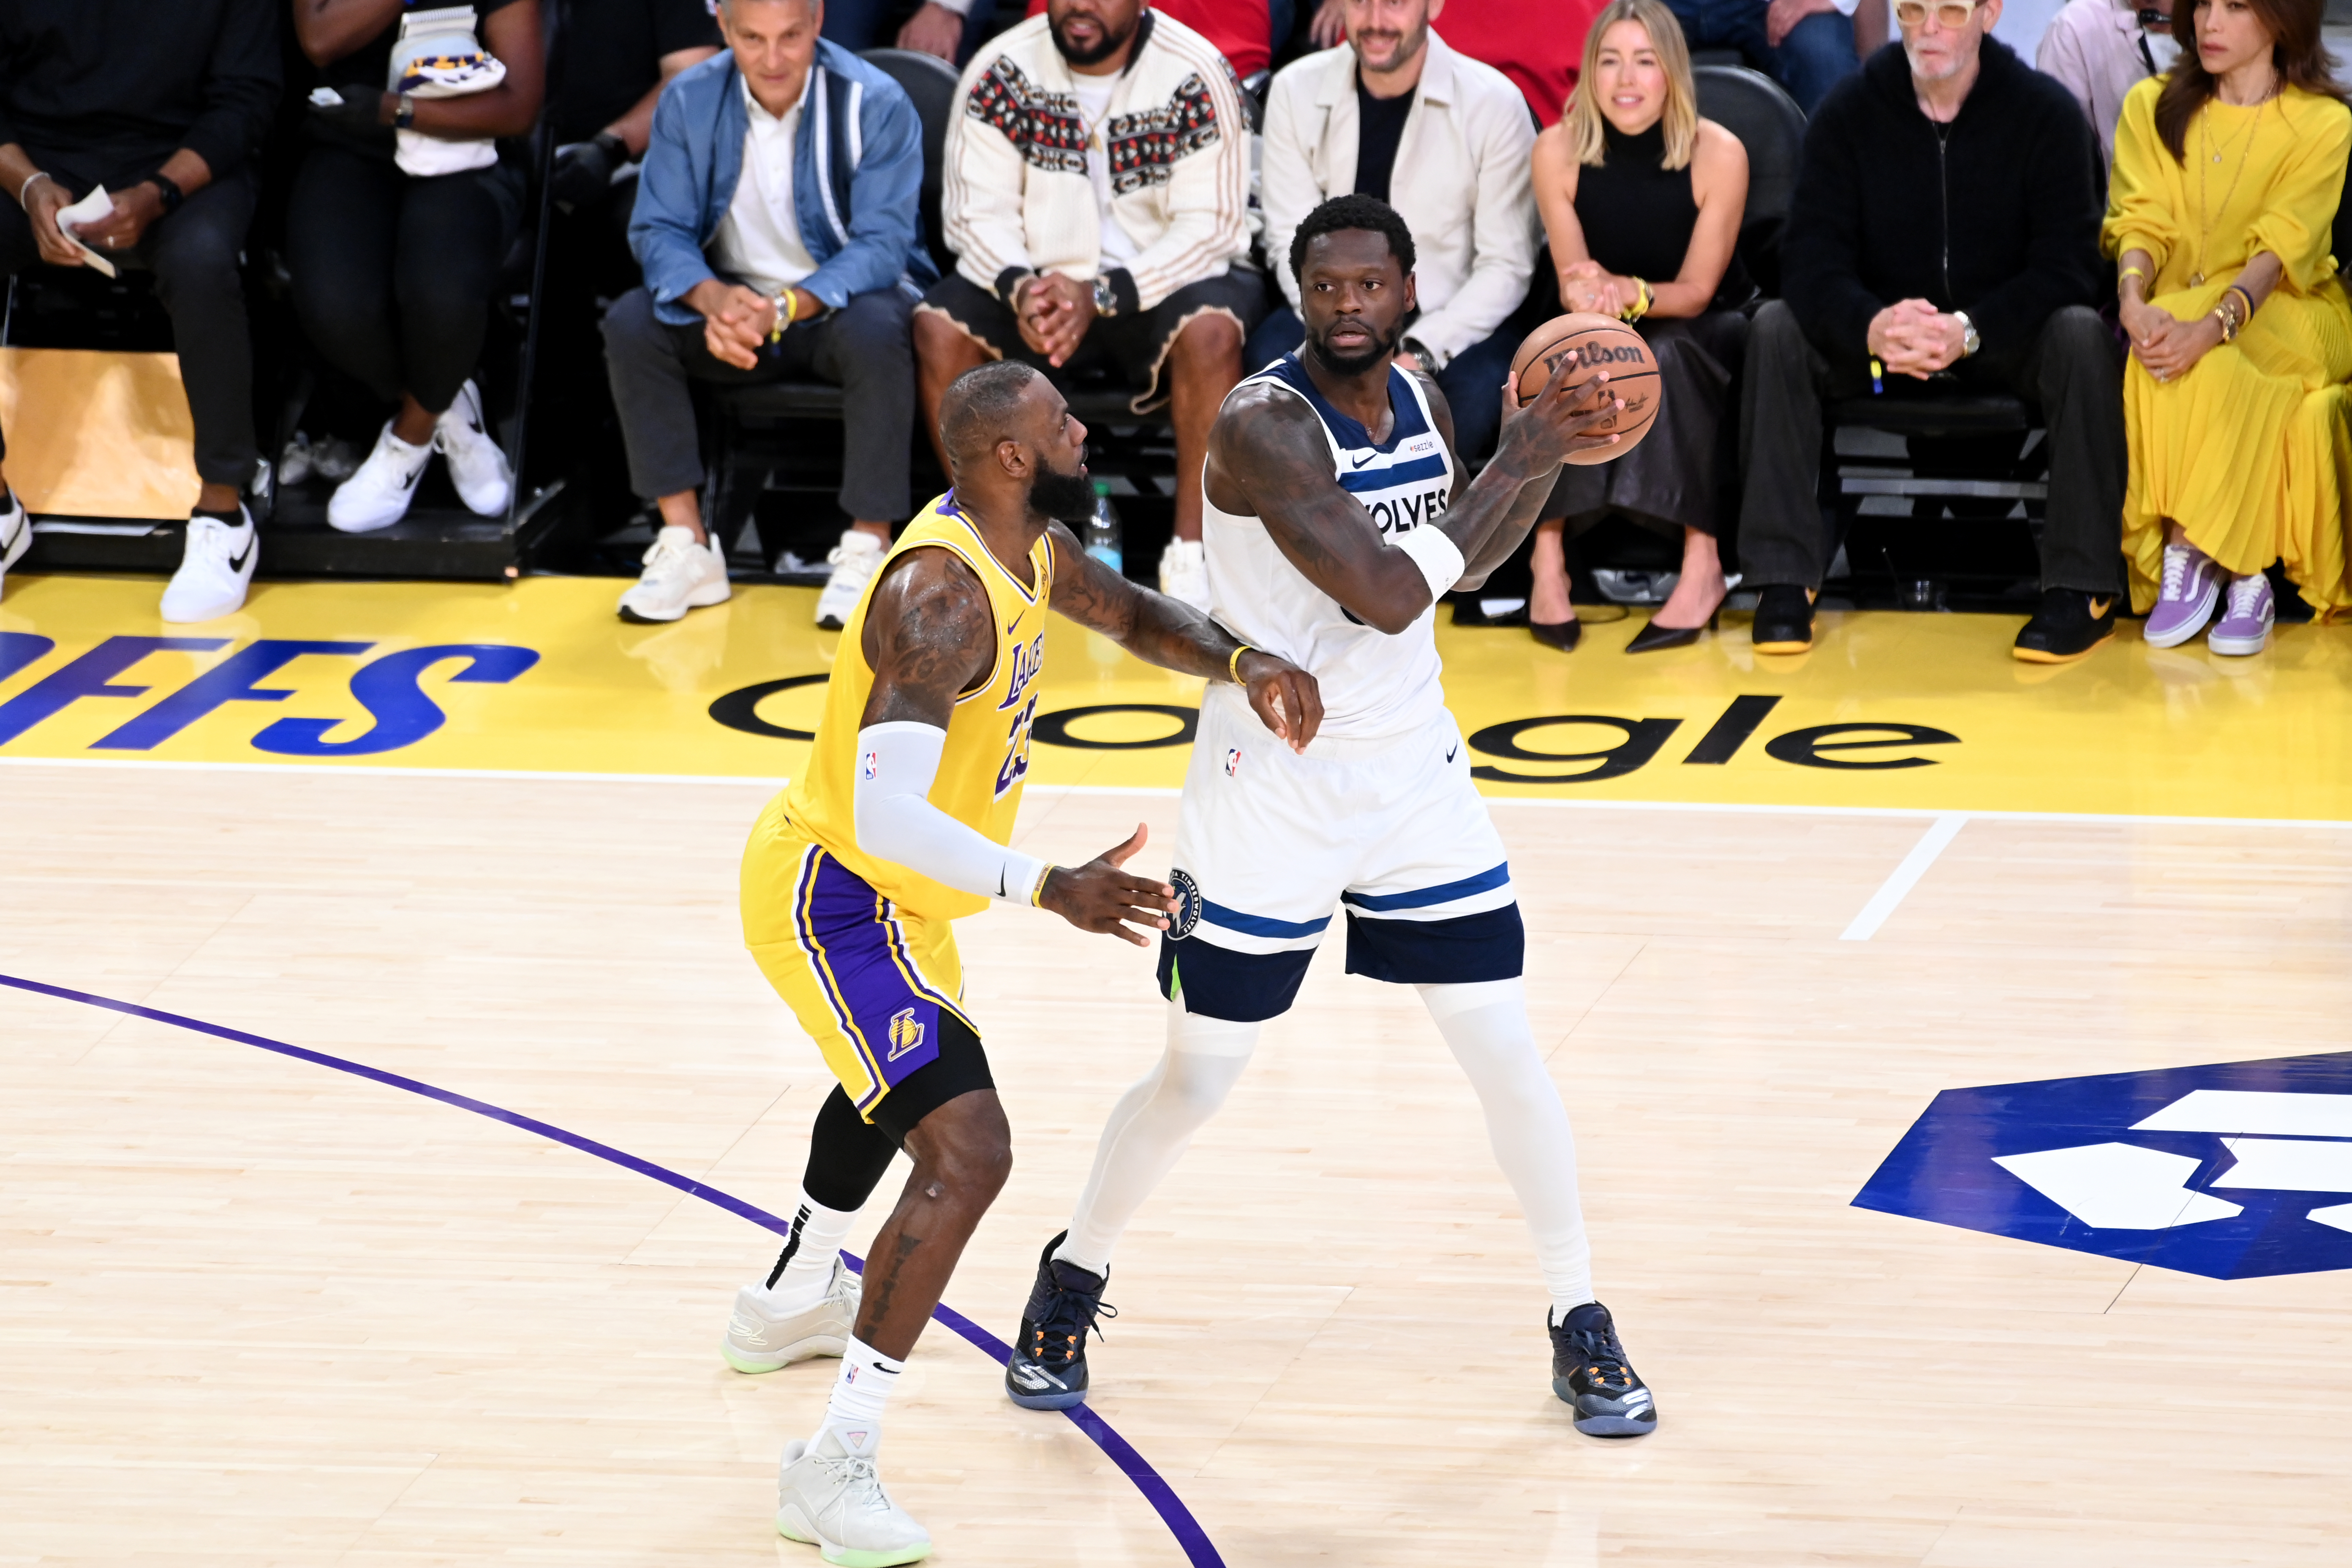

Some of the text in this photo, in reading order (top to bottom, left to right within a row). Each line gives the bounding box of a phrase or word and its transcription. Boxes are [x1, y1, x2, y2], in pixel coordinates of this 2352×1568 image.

[1413, 439, 1434, 452] sezzle
[1365, 488, 1446, 534] OLVES
[996, 629, 1045, 712] LAKE
[1181, 873, 1200, 933] TIMBERWOLVES
